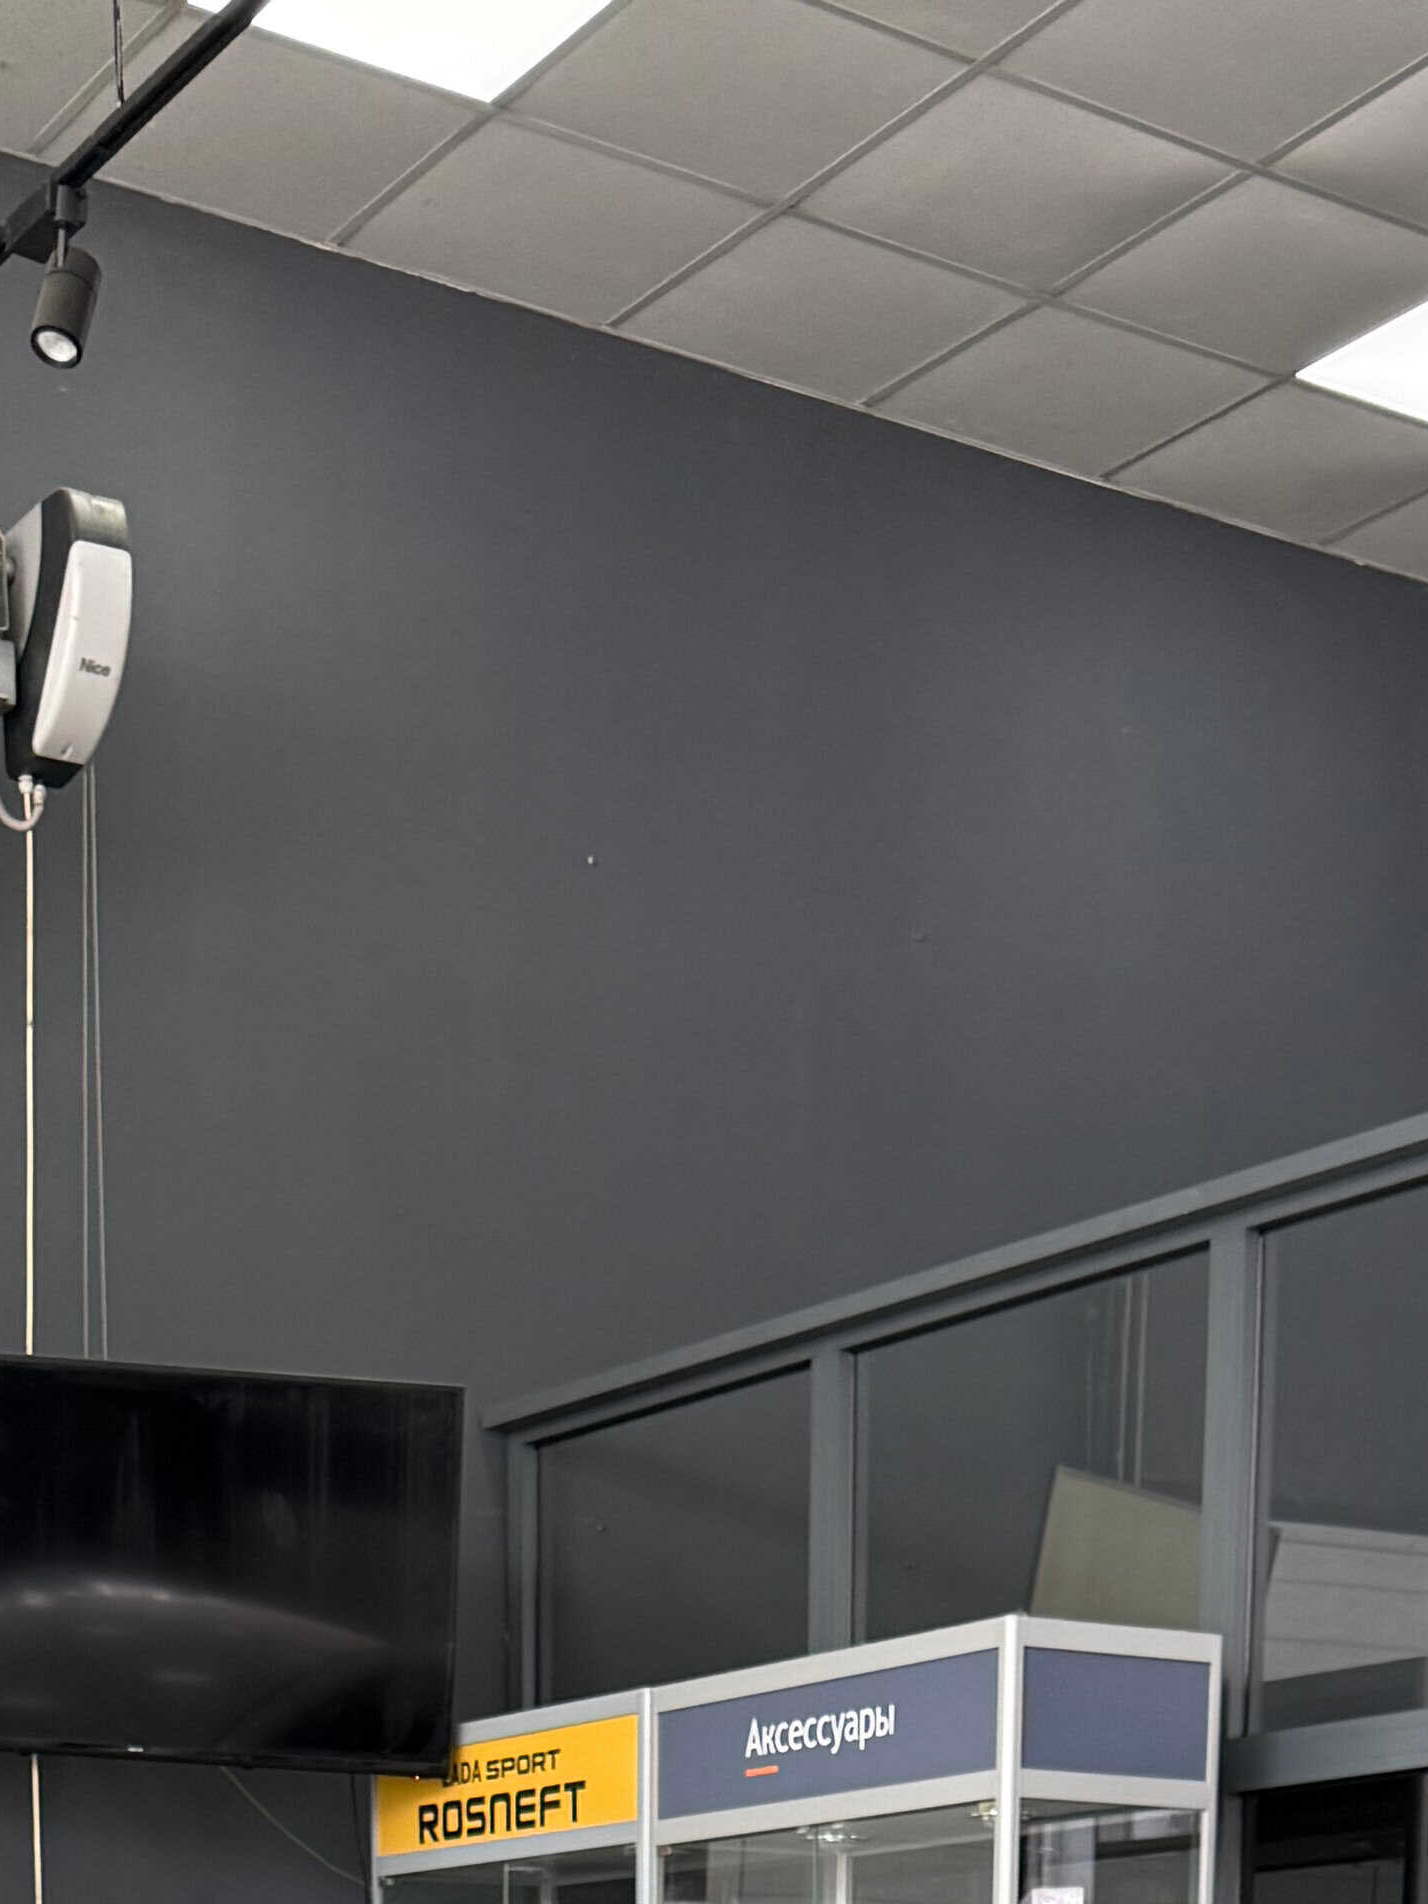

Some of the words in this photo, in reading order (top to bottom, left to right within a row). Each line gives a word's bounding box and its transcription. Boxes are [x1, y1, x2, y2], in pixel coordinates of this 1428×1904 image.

[79, 657, 111, 677] Nice
[744, 1703, 896, 1755] Аксессуары
[486, 1749, 561, 1780] SPORT
[418, 1780, 586, 1845] ROSNEFT
